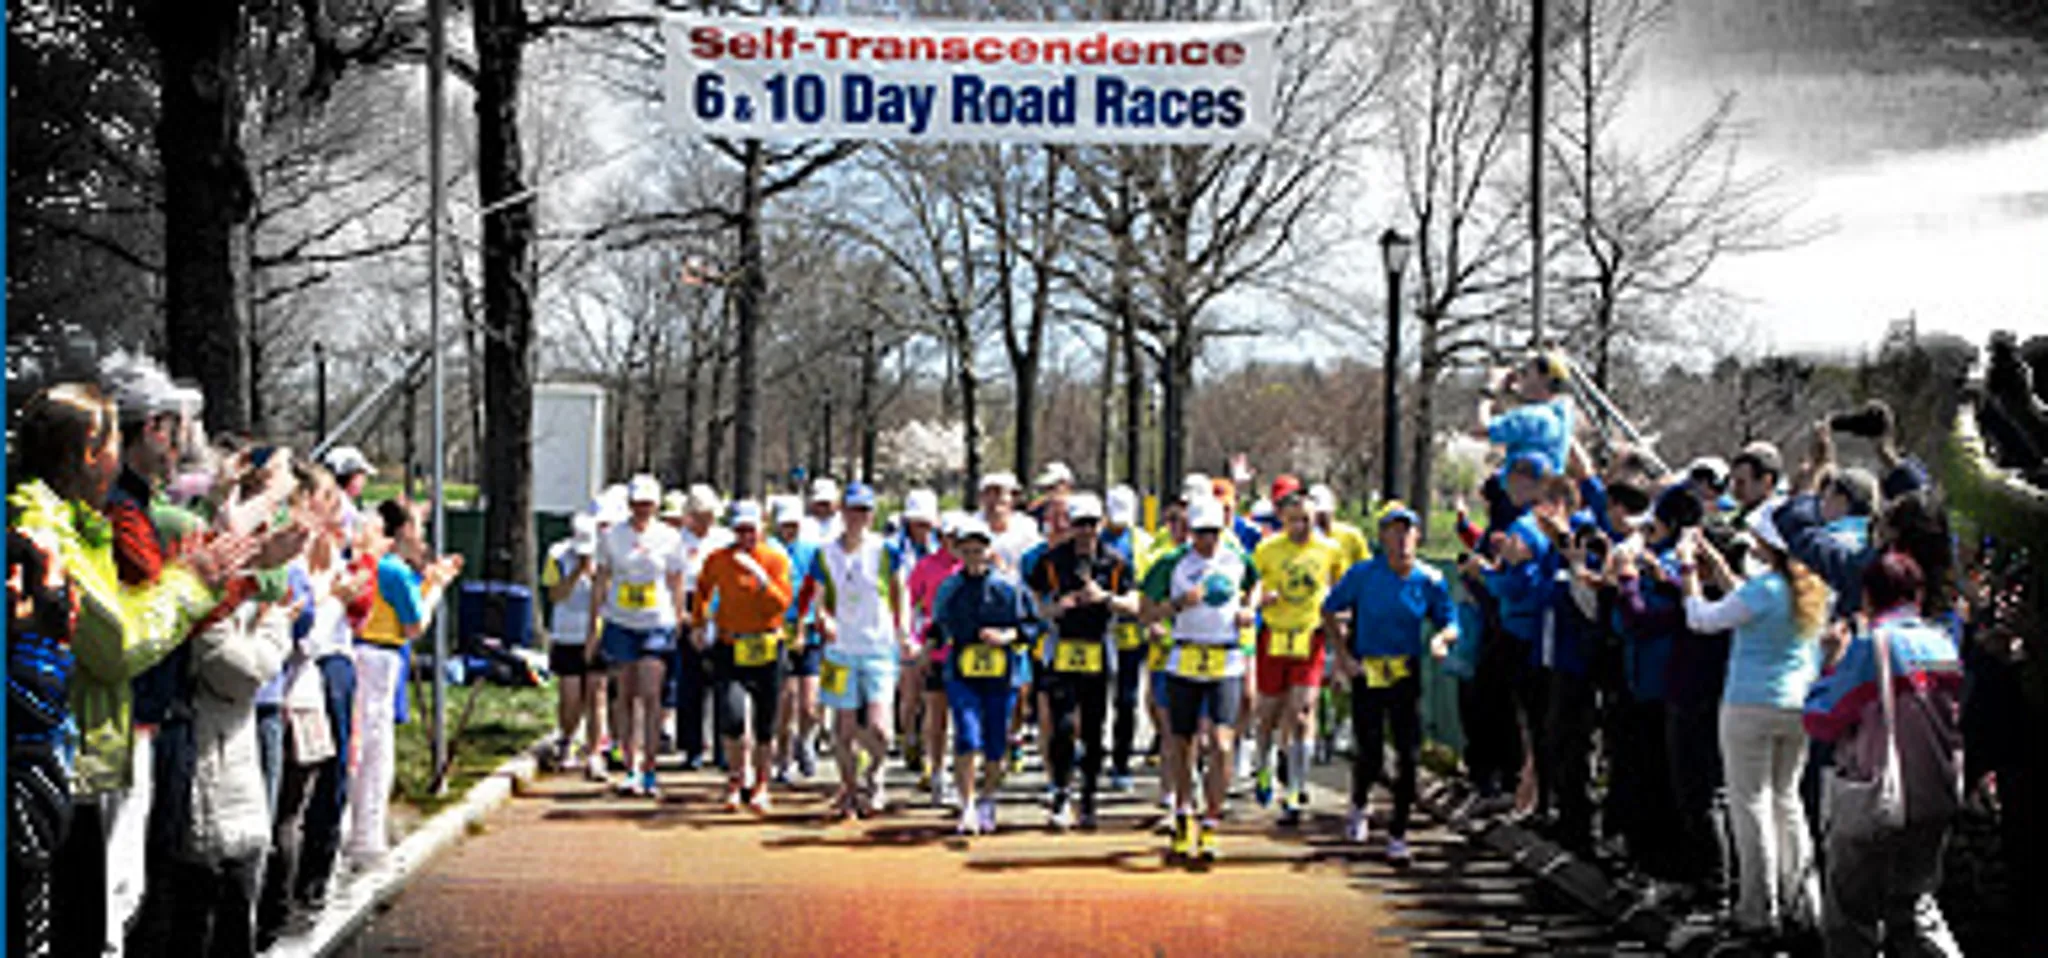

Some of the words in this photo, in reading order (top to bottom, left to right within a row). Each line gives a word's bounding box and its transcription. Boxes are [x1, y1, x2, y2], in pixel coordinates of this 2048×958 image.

[689, 26, 1246, 66] Self-Transcendence
[695, 71, 725, 120] 6
[733, 94, 755, 122] &
[763, 72, 826, 124] 10
[842, 73, 936, 134] Day
[952, 74, 1077, 126] Road
[1096, 75, 1245, 128] Races
